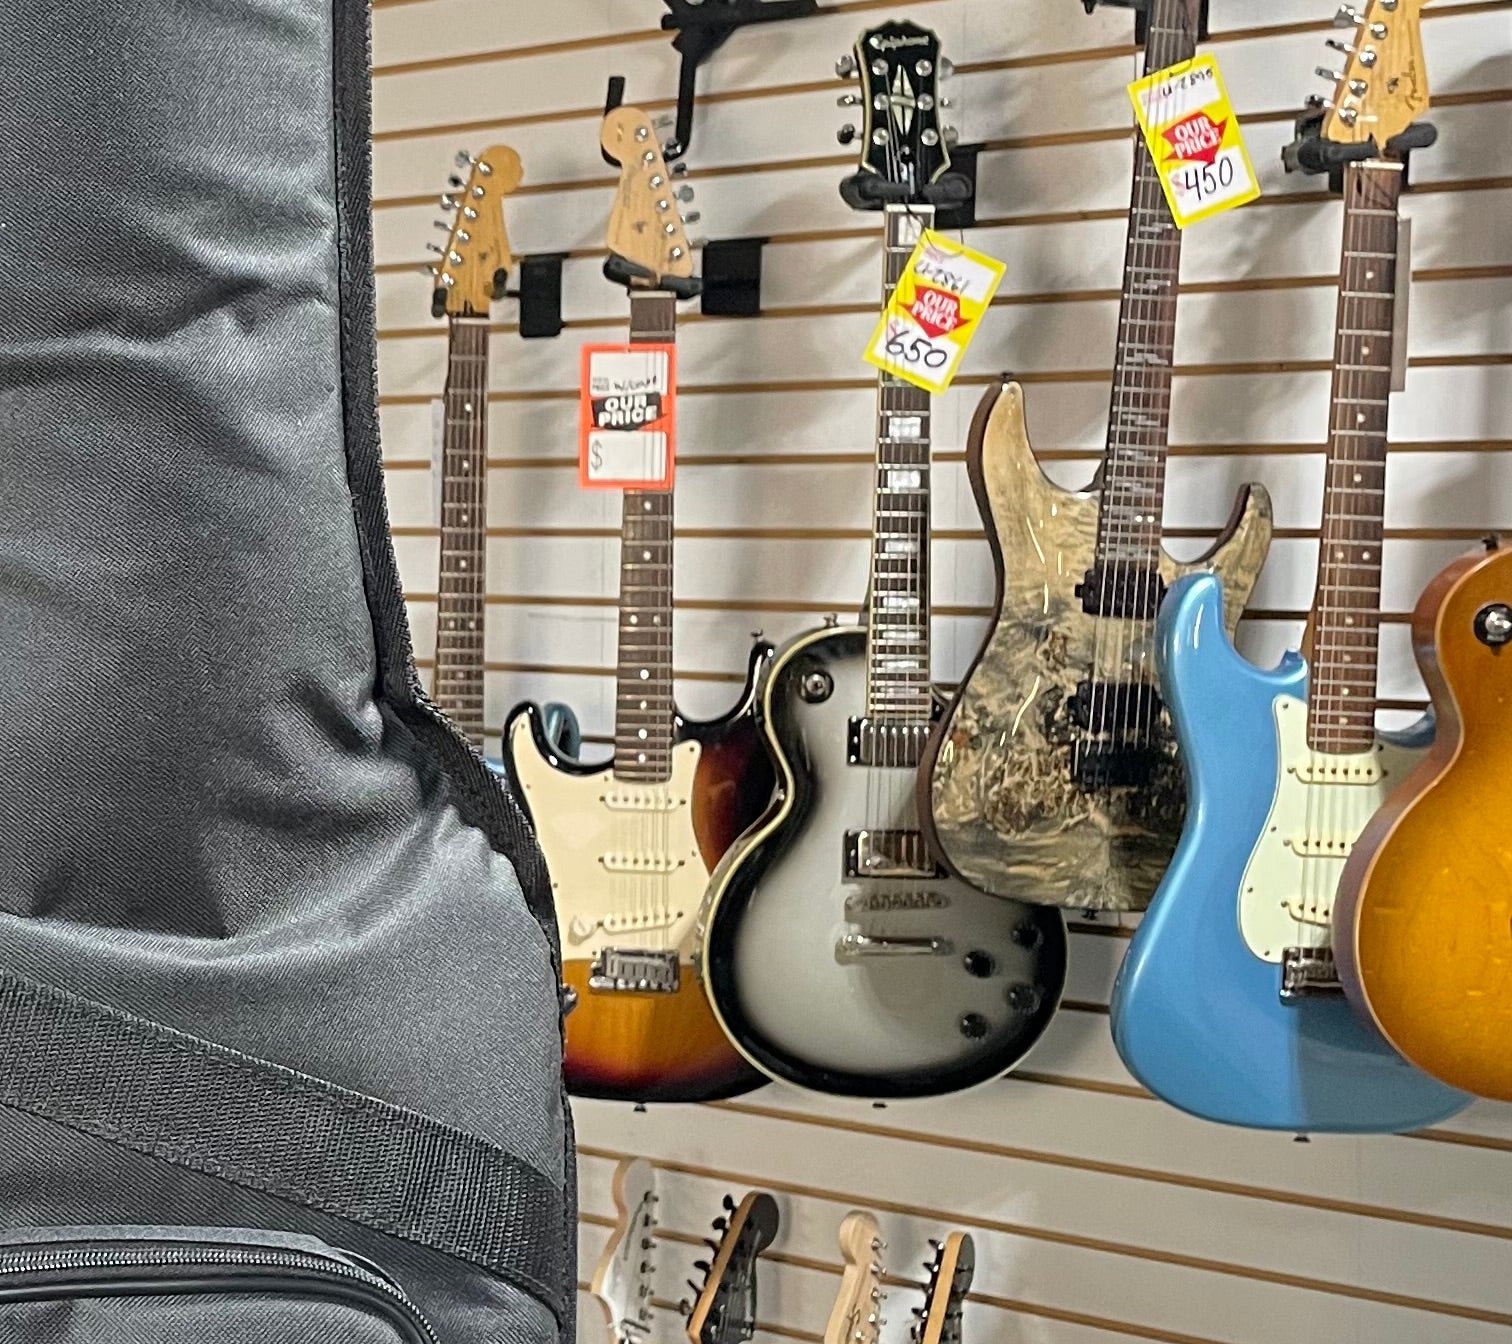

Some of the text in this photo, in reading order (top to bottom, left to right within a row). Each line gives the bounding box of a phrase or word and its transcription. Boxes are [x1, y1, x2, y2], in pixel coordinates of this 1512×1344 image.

[1174, 116, 1212, 142] OUR
[1174, 127, 1222, 159] PRICE
[911, 301, 958, 332] PRICE
[922, 289, 959, 318] OUR
[598, 404, 657, 427] PRICE
[604, 394, 647, 412] OUR
